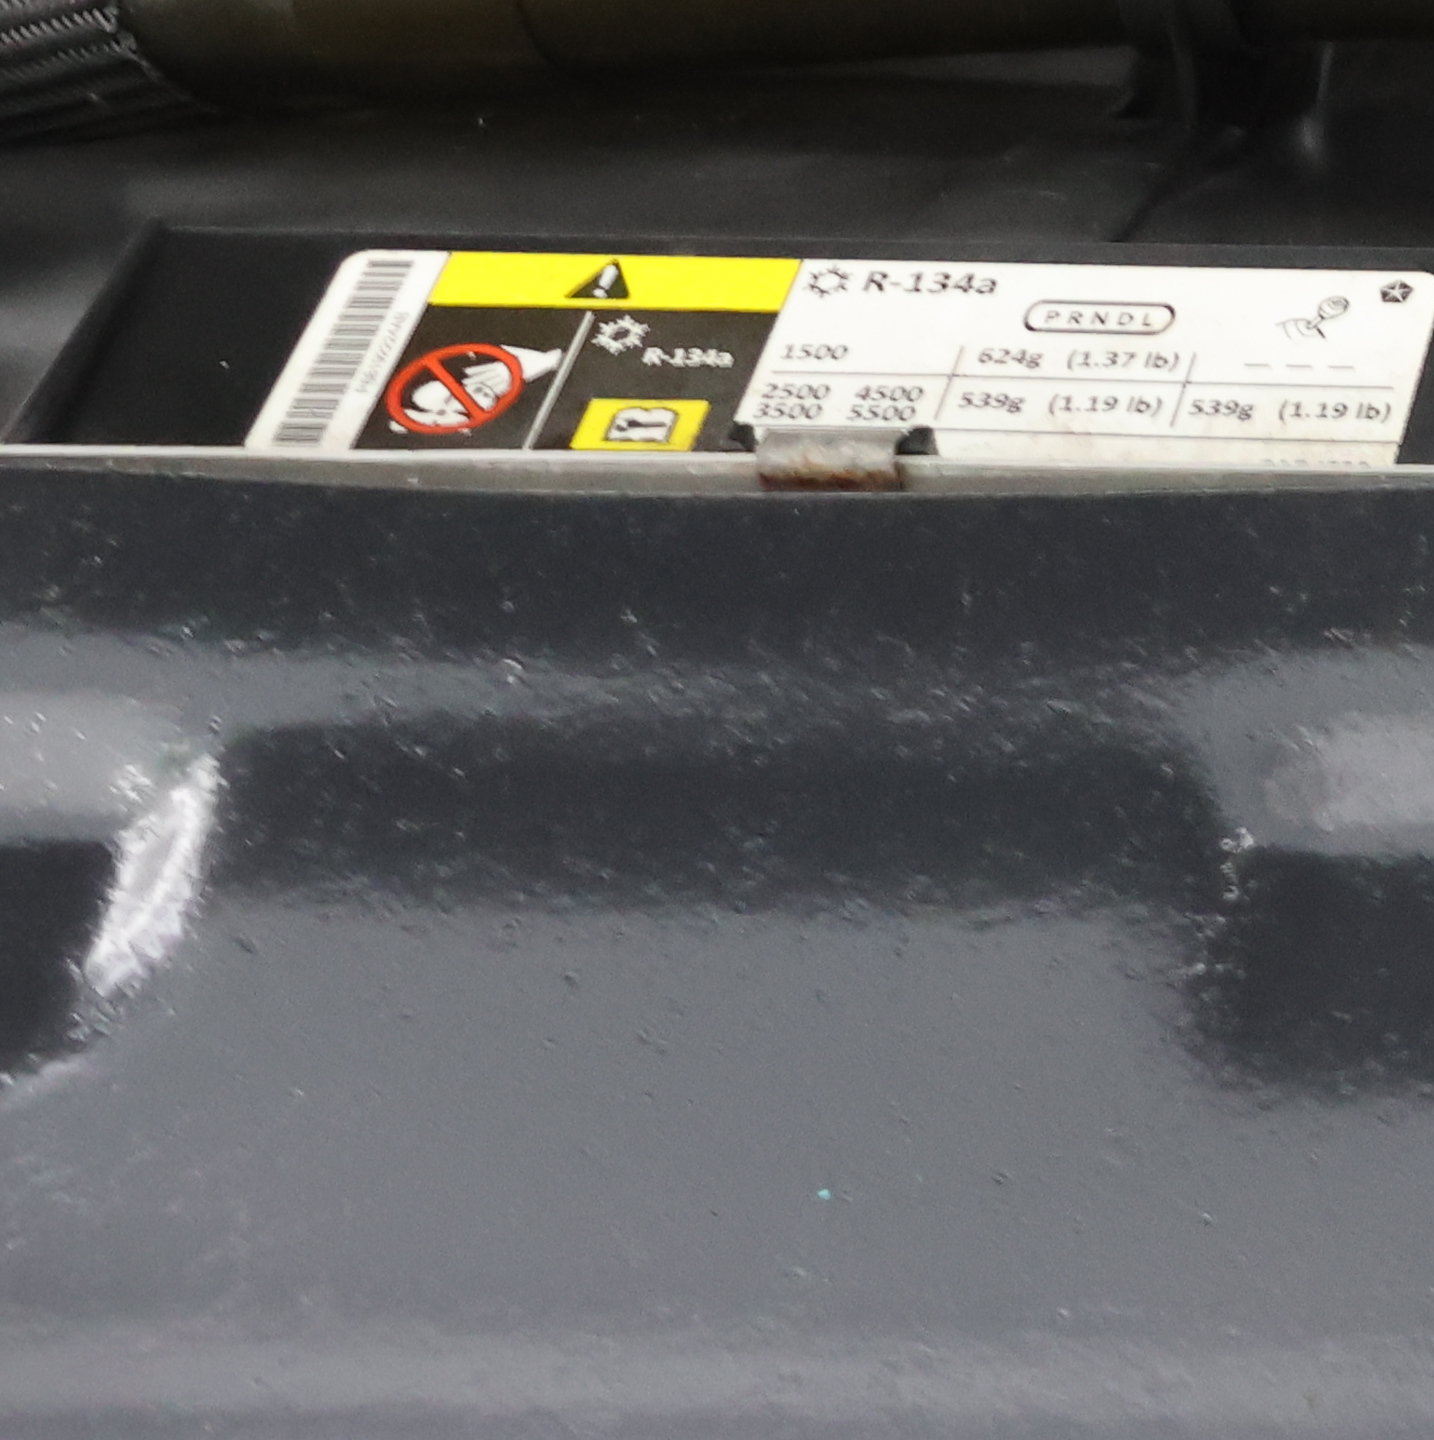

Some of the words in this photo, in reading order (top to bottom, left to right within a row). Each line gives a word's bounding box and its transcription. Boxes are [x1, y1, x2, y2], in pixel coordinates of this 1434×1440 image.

[863, 271, 998, 295] R-134a
[641, 347, 735, 368] R-134a
[780, 344, 849, 361] 1500
[977, 348, 1044, 370] 624g
[1066, 349, 1137, 371] (1.37
[1144, 351, 1180, 372] lb)
[761, 383, 832, 400] 2500
[854, 385, 924, 403] 4500
[957, 392, 1026, 414] 539g
[1048, 393, 1119, 417] (1.19
[1127, 395, 1164, 418] lb)
[752, 403, 823, 420] 3500
[845, 404, 917, 422] 5500
[1187, 399, 1255, 421] 539g
[1277, 400, 1349, 425] (1.19
[1355, 402, 1393, 424] lb)
